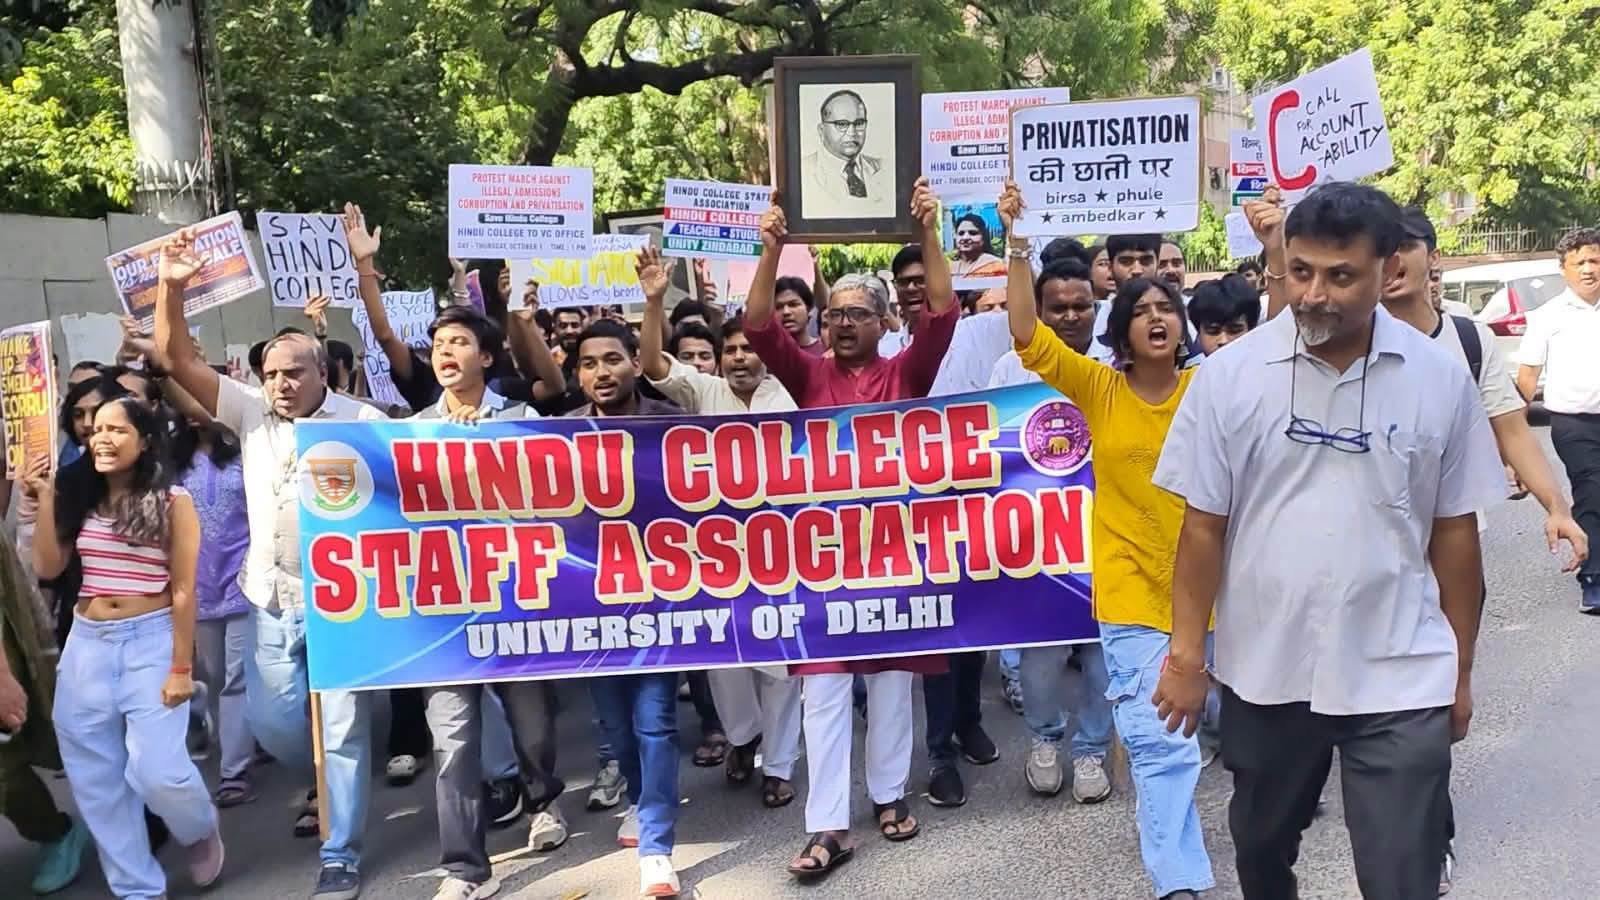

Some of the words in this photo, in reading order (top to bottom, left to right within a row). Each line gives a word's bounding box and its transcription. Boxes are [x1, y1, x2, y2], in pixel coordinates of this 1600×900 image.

[943, 101, 978, 112] PROTEST
[981, 99, 1009, 110] MARCH
[1305, 87, 1341, 115] CALL
[953, 115, 984, 126] ILLEGAL
[1296, 118, 1313, 131] FOR
[929, 129, 983, 142] CORRUPTION
[984, 128, 999, 139] AND
[1022, 114, 1189, 151] PRIVATISATION
[1300, 102, 1369, 155] ACCOUNT
[930, 161, 957, 172] HINDU
[960, 160, 999, 170] COLLEGE
[1028, 157, 1064, 183] की
[1072, 154, 1131, 181] छाती
[1139, 158, 1173, 178] पर
[472, 173, 506, 184] PROTEST
[508, 174, 536, 185] MARCH
[539, 175, 570, 185] AGAINST
[481, 186, 512, 196] ILLEGAL
[515, 187, 561, 198] ADMISSIONS
[672, 186, 699, 196] HINDU
[703, 188, 739, 199] COLLEGE
[1046, 191, 1086, 205] birsa
[1116, 187, 1163, 205] phule
[458, 199, 508, 209] CORRUPTION
[511, 200, 525, 210] AND
[528, 200, 584, 211] PRIVATISATION
[693, 198, 750, 211] ASSOCIATION
[670, 208, 706, 221] HINDU
[1061, 208, 1146, 224] ambedkar
[269, 215, 337, 237] SAV
[457, 227, 484, 237] HINDU
[487, 228, 525, 238] COLLEGE
[528, 229, 538, 238] TO
[541, 229, 552, 238] VC
[555, 229, 585, 239] OFFICE
[678, 223, 720, 237] TEACHER
[667, 237, 699, 250] UNITY
[701, 240, 754, 255] ZINDABAD
[116, 257, 147, 281] OUR
[274, 276, 359, 300] COLLEG
[592, 288, 610, 301] my
[400, 294, 432, 305] LIFE
[403, 304, 433, 317] YOU
[3, 393, 47, 418] CORRU
[392, 431, 633, 519] HINDU
[663, 403, 1000, 511] COLLEGE
[310, 524, 565, 621] STAFF
[596, 487, 1092, 605] ASSOCIATION
[466, 608, 731, 658] UNIVERSITY
[751, 603, 805, 641] OF
[825, 595, 955, 636] DELHI
